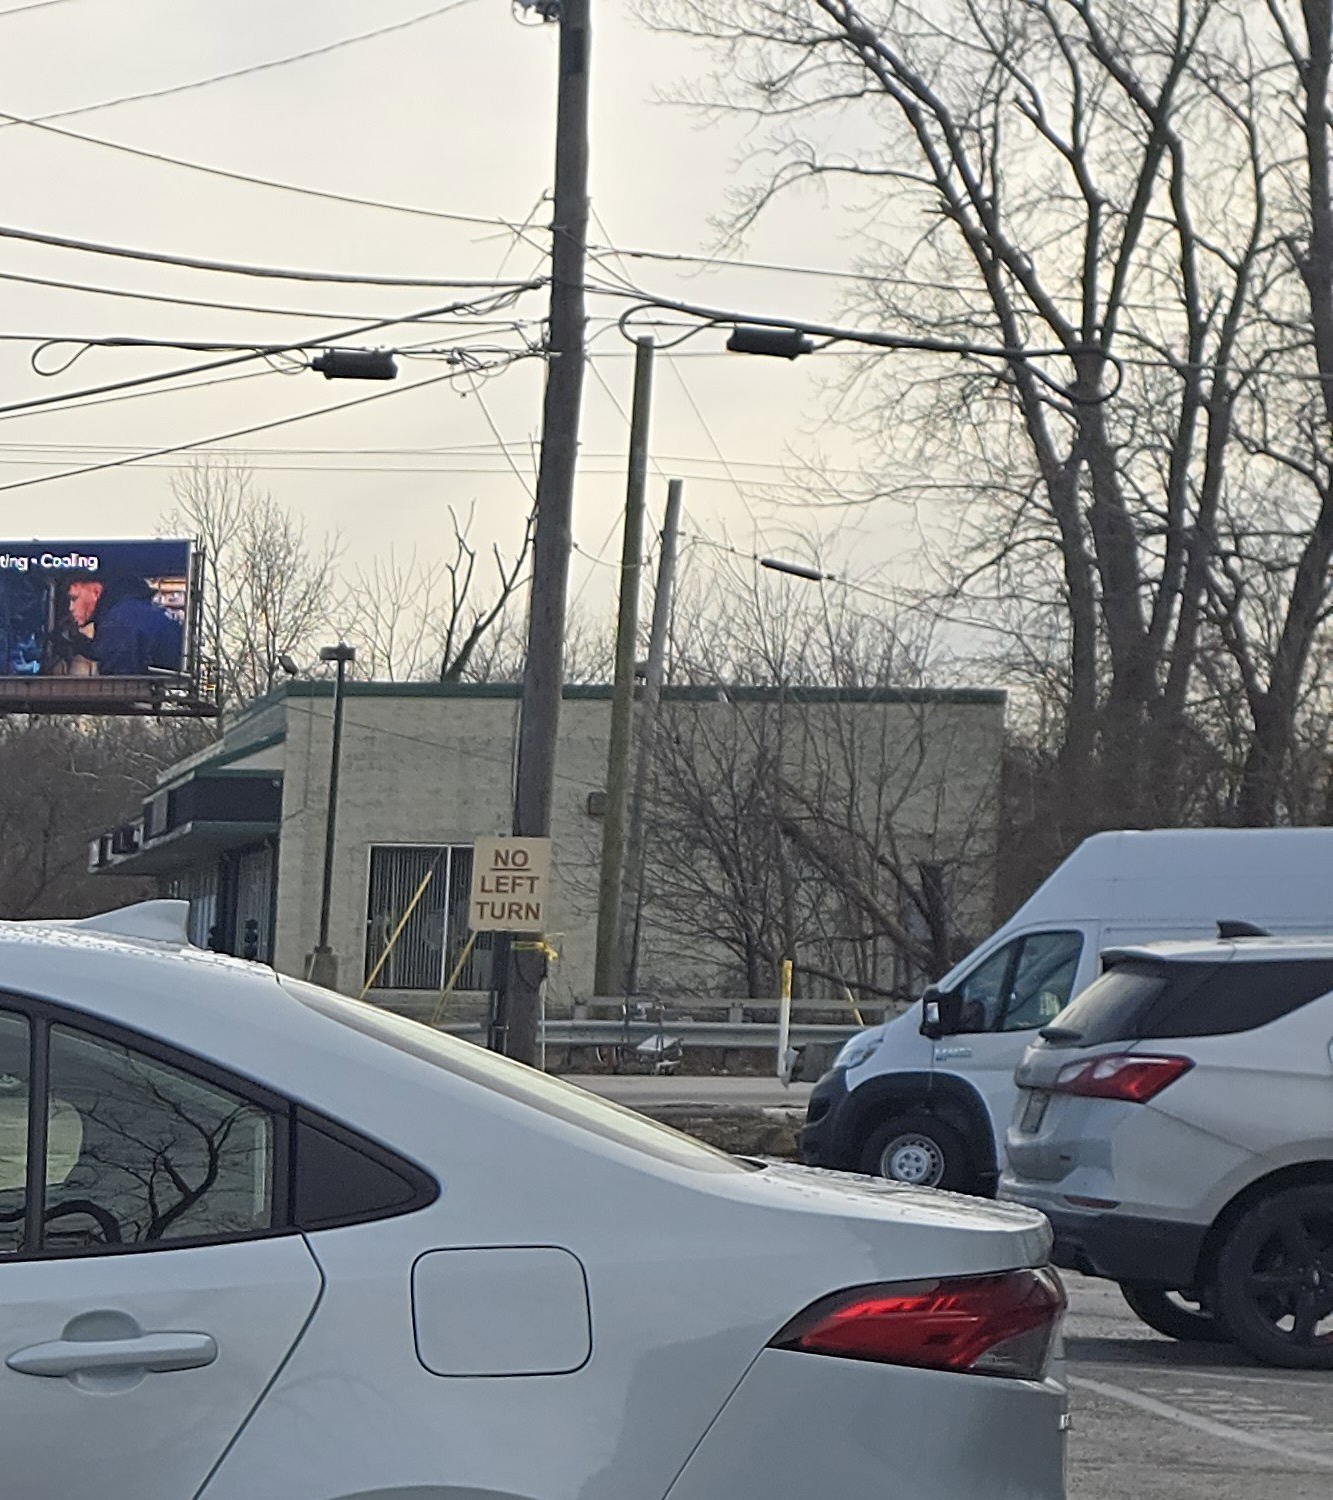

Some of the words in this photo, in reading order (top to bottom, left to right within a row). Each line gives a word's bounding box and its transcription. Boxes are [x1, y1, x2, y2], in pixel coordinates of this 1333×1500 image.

[40, 553, 99, 571] Cooling
[494, 849, 529, 867] NO
[480, 875, 540, 893] LEFT
[475, 902, 541, 920] TURN
